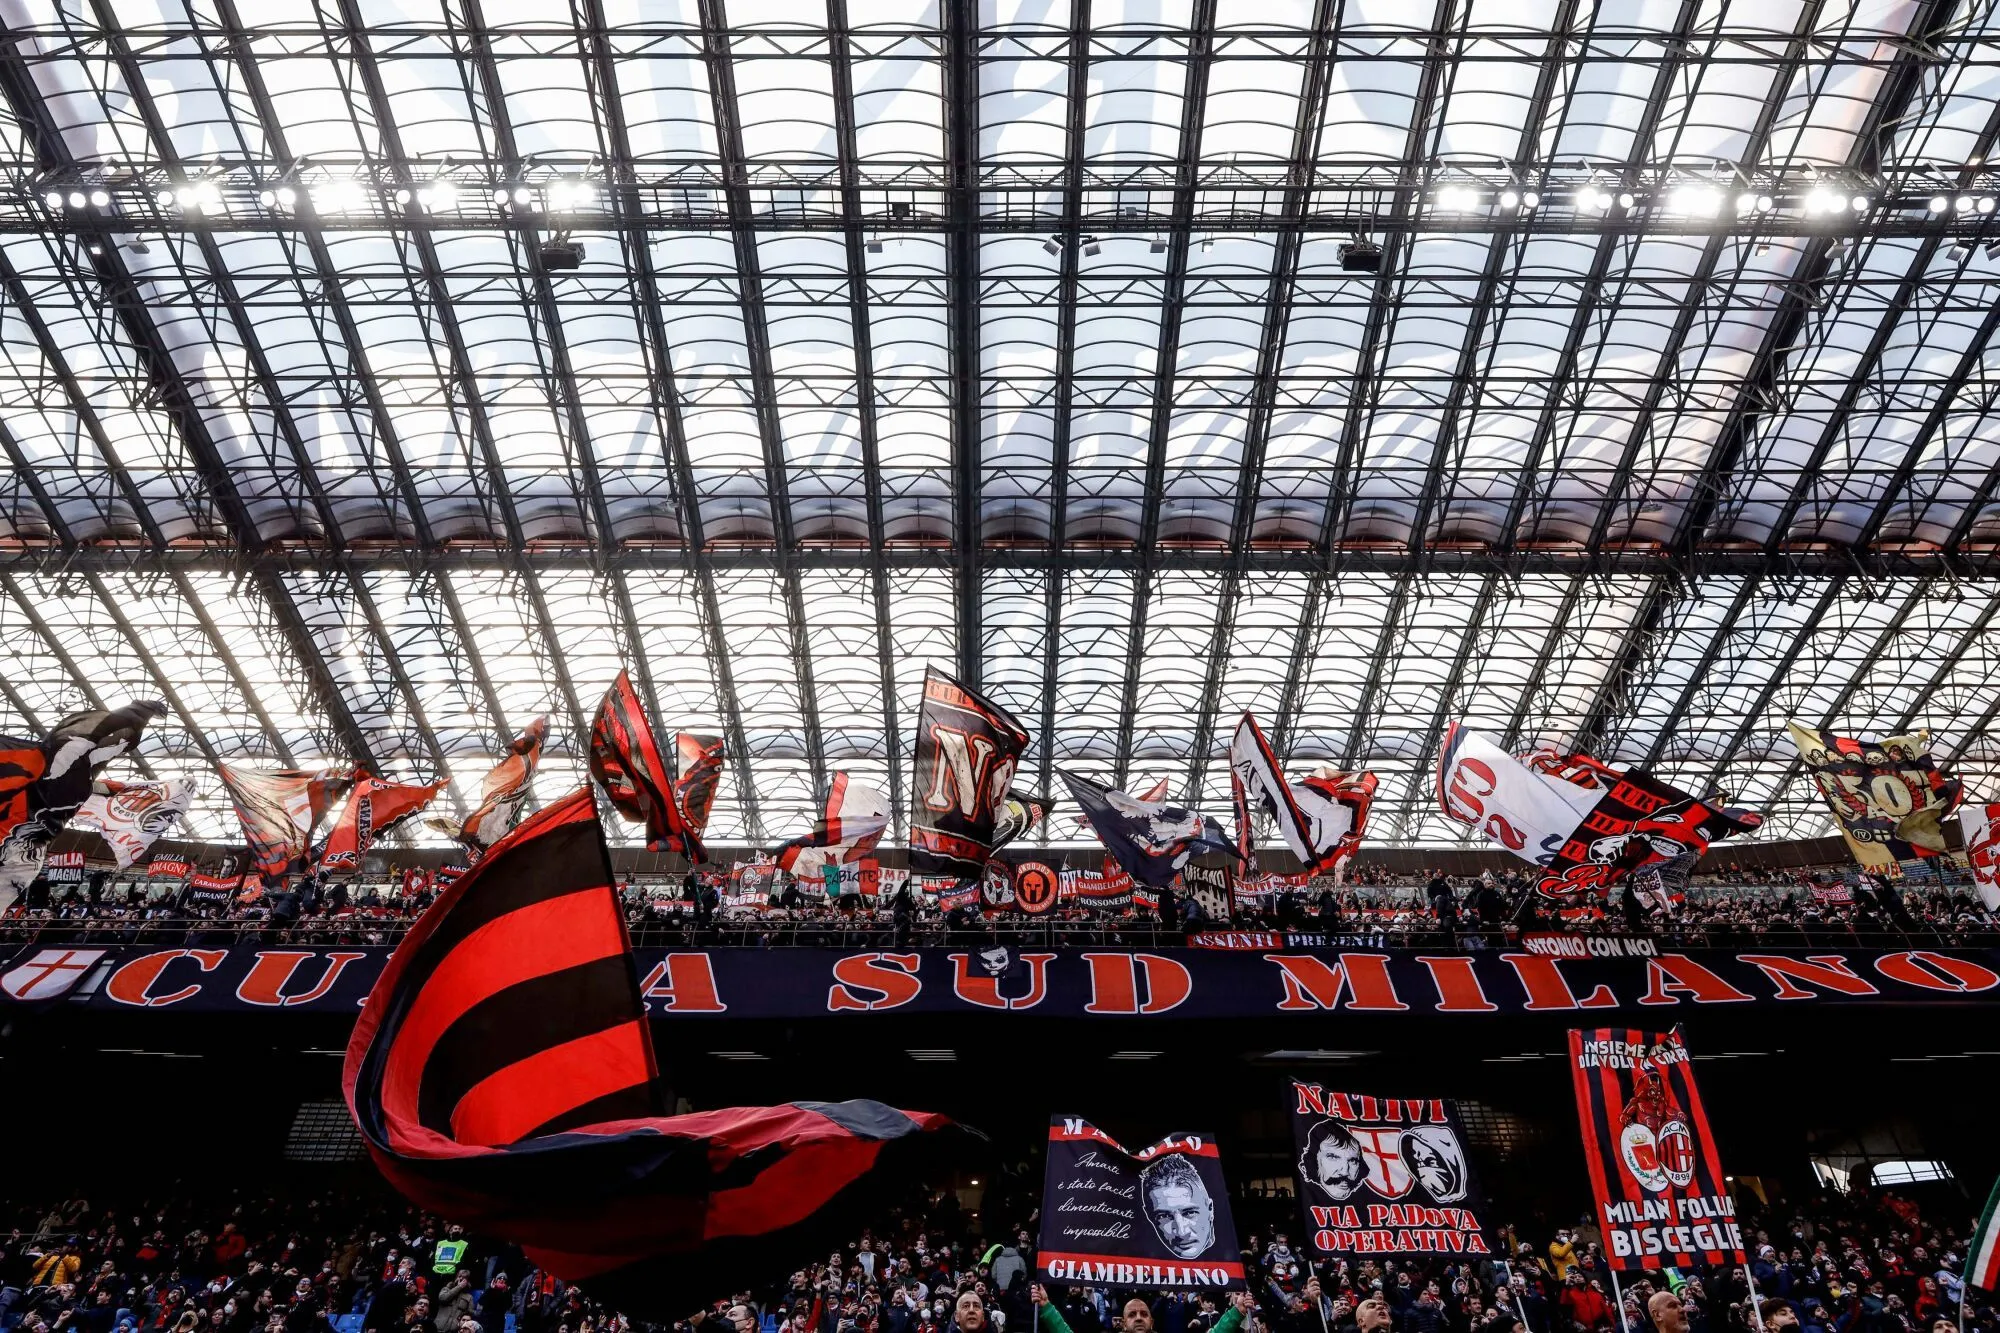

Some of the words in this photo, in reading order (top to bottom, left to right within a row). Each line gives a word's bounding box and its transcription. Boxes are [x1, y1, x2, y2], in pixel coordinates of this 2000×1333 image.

[154, 853, 185, 863] EMILIA
[1078, 876, 1130, 891] GIAMBELLINO
[1184, 864, 1226, 889] MILANO
[1080, 895, 1131, 906] ROSSONERO
[1193, 933, 1276, 948] ASSENTI
[1586, 937, 1621, 957] CON
[1625, 938, 1658, 957] NOI
[105, 949, 728, 1013] CUA
[827, 951, 1193, 1014] SUD
[1263, 951, 2000, 1012] MILANO
[1584, 1040, 1647, 1058] INSIEME
[1578, 1053, 1636, 1070] DIAVOLO
[1292, 1081, 1449, 1123] NATIVI
[1662, 1121, 1689, 1136] ACM
[1670, 1170, 1690, 1182] 1899
[1067, 1177, 1097, 1191] stato
[1098, 1181, 1135, 1200] facile
[1310, 1205, 1363, 1228] VIA
[1367, 1203, 1482, 1231] PADOVA
[1603, 1198, 1672, 1224] MILAN
[1677, 1195, 1737, 1220] FOLLIA
[1062, 1221, 1131, 1241] impossibile
[1314, 1228, 1491, 1254] OPERATIVA
[1609, 1222, 1745, 1258] BISCEGLIE
[1048, 1258, 1230, 1287] GIAMBELLINO
